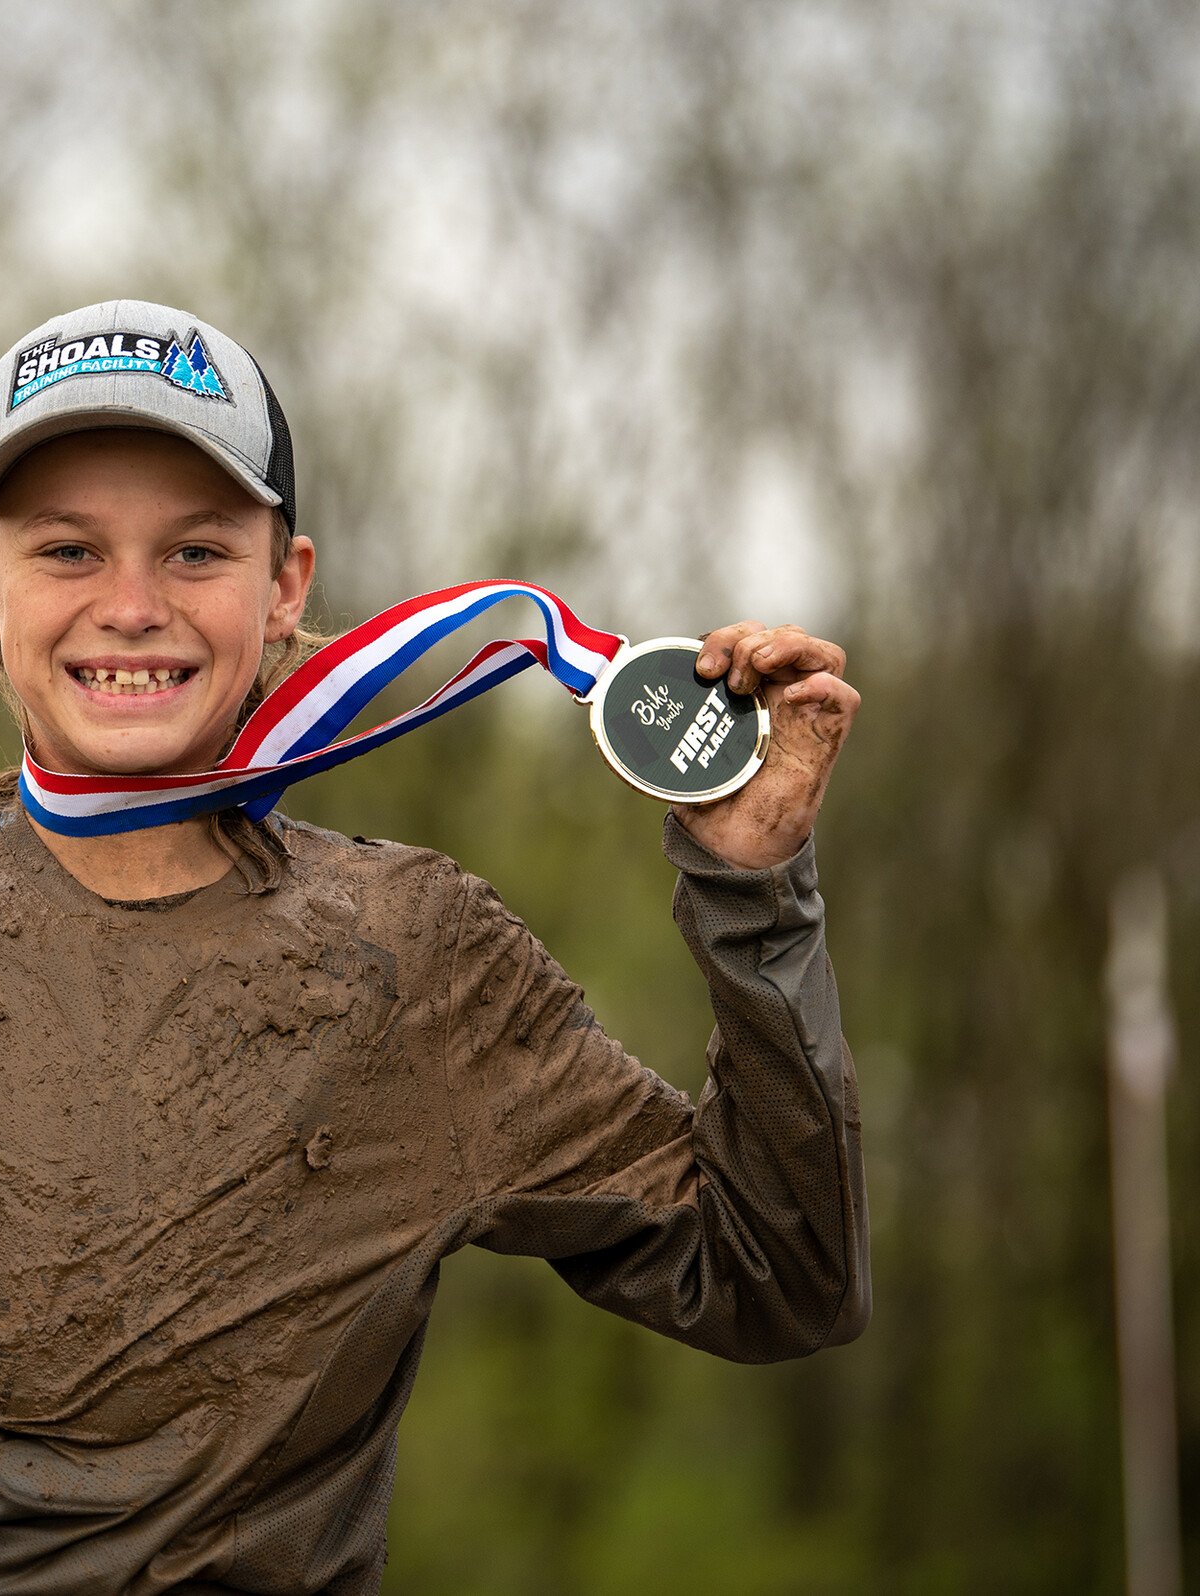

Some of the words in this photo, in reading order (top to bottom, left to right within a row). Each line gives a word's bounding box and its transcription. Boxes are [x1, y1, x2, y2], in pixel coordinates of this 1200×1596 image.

[17, 335, 161, 386] SHOALS
[21, 340, 56, 361] THE
[16, 364, 78, 401] TRAINING
[81, 358, 159, 372] FACILITY
[631, 684, 669, 725] Bike
[656, 699, 685, 731] Youth
[670, 688, 727, 775] FIRST
[697, 713, 736, 769] PLACE
